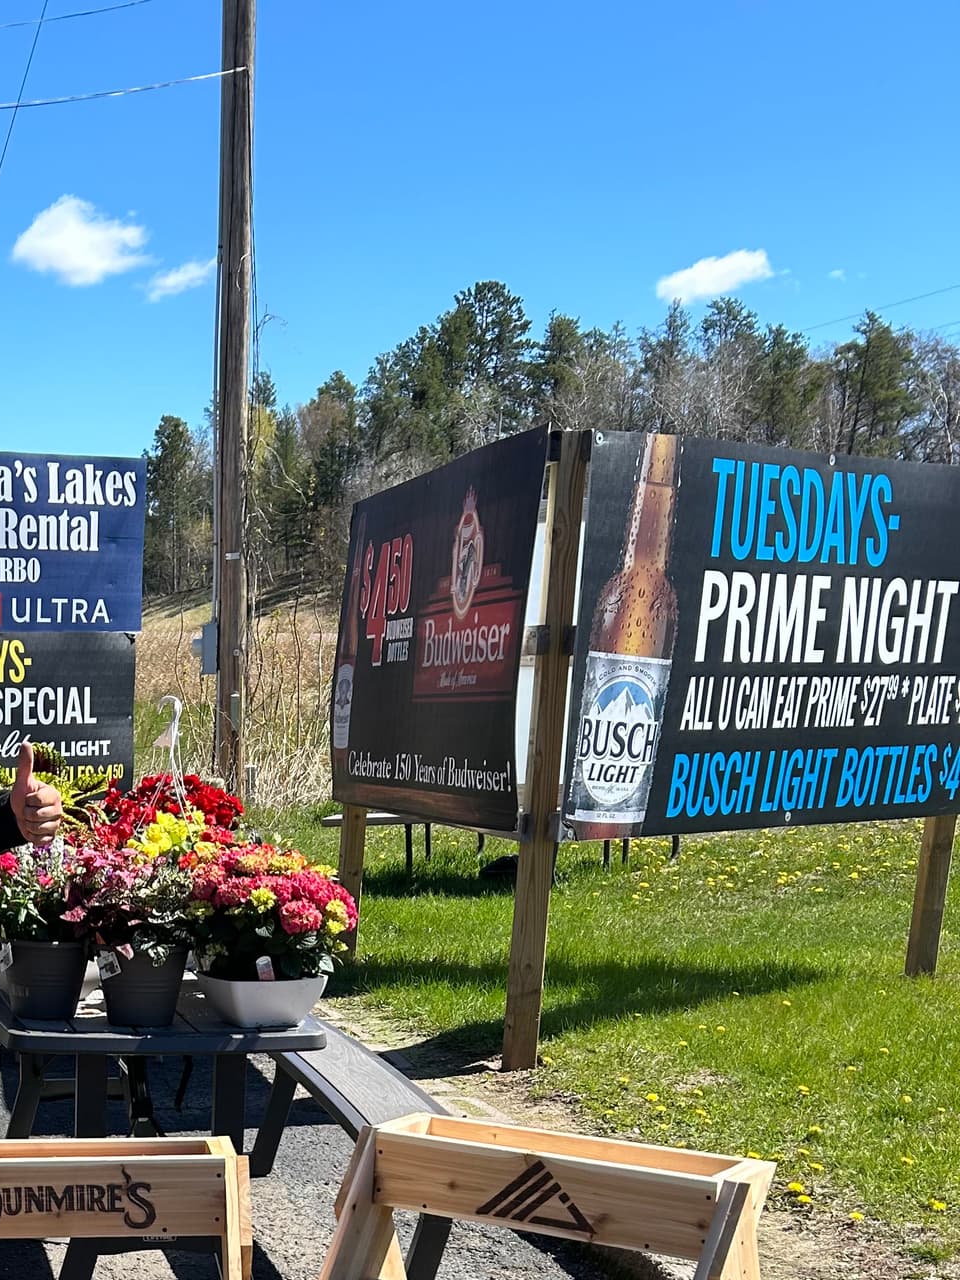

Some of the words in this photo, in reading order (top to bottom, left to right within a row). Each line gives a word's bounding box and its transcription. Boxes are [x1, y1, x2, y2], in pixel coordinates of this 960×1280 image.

[47, 462, 137, 507] Lakes
[711, 457, 900, 567] TUESDAYS-
[11, 598, 110, 624] ULTRA
[694, 570, 831, 663] PRIME
[836, 577, 959, 664] NIGHT
[422, 611, 510, 668] Budweiser
[680, 676, 714, 730] ALL
[718, 676, 735, 730] U
[735, 676, 773, 729] CAN
[772, 676, 806, 728] EAT
[804, 676, 861, 727] PRIME
[907, 675, 956, 725] PLATE
[60, 740, 111, 756] LIGHT
[580, 720, 657, 763] BUSCH
[348, 750, 392, 779] Celebrate
[394, 753, 411, 781] 150
[414, 754, 436, 784] Years
[437, 756, 447, 785] of
[447, 757, 512, 792] Budweiser!
[587, 763, 639, 784] LIGHT
[665, 751, 759, 818] BUSCH
[760, 747, 838, 812] LIGHT
[836, 743, 937, 807] BOTTLES
